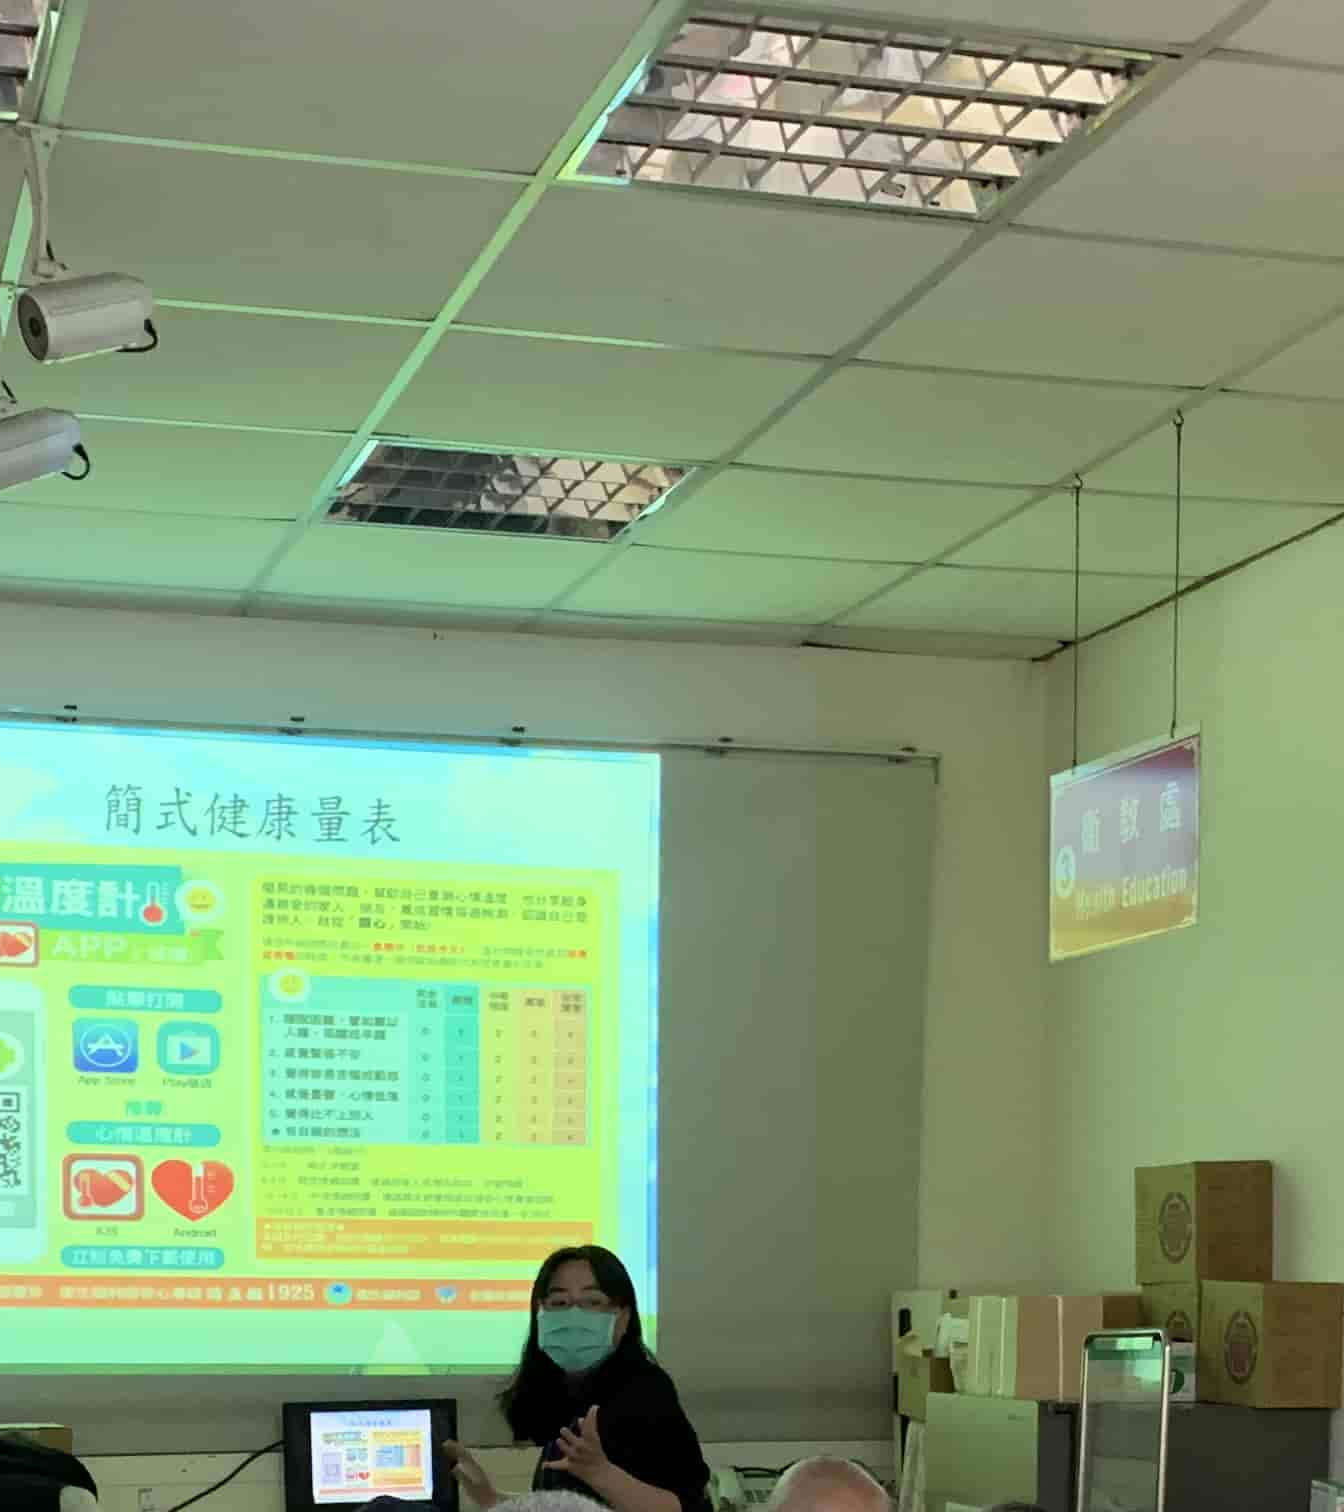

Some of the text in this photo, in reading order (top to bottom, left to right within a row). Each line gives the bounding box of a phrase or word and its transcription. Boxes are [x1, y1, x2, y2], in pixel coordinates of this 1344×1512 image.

[105, 784, 401, 846] 簡式健康量表
[51, 935, 128, 959] APP
